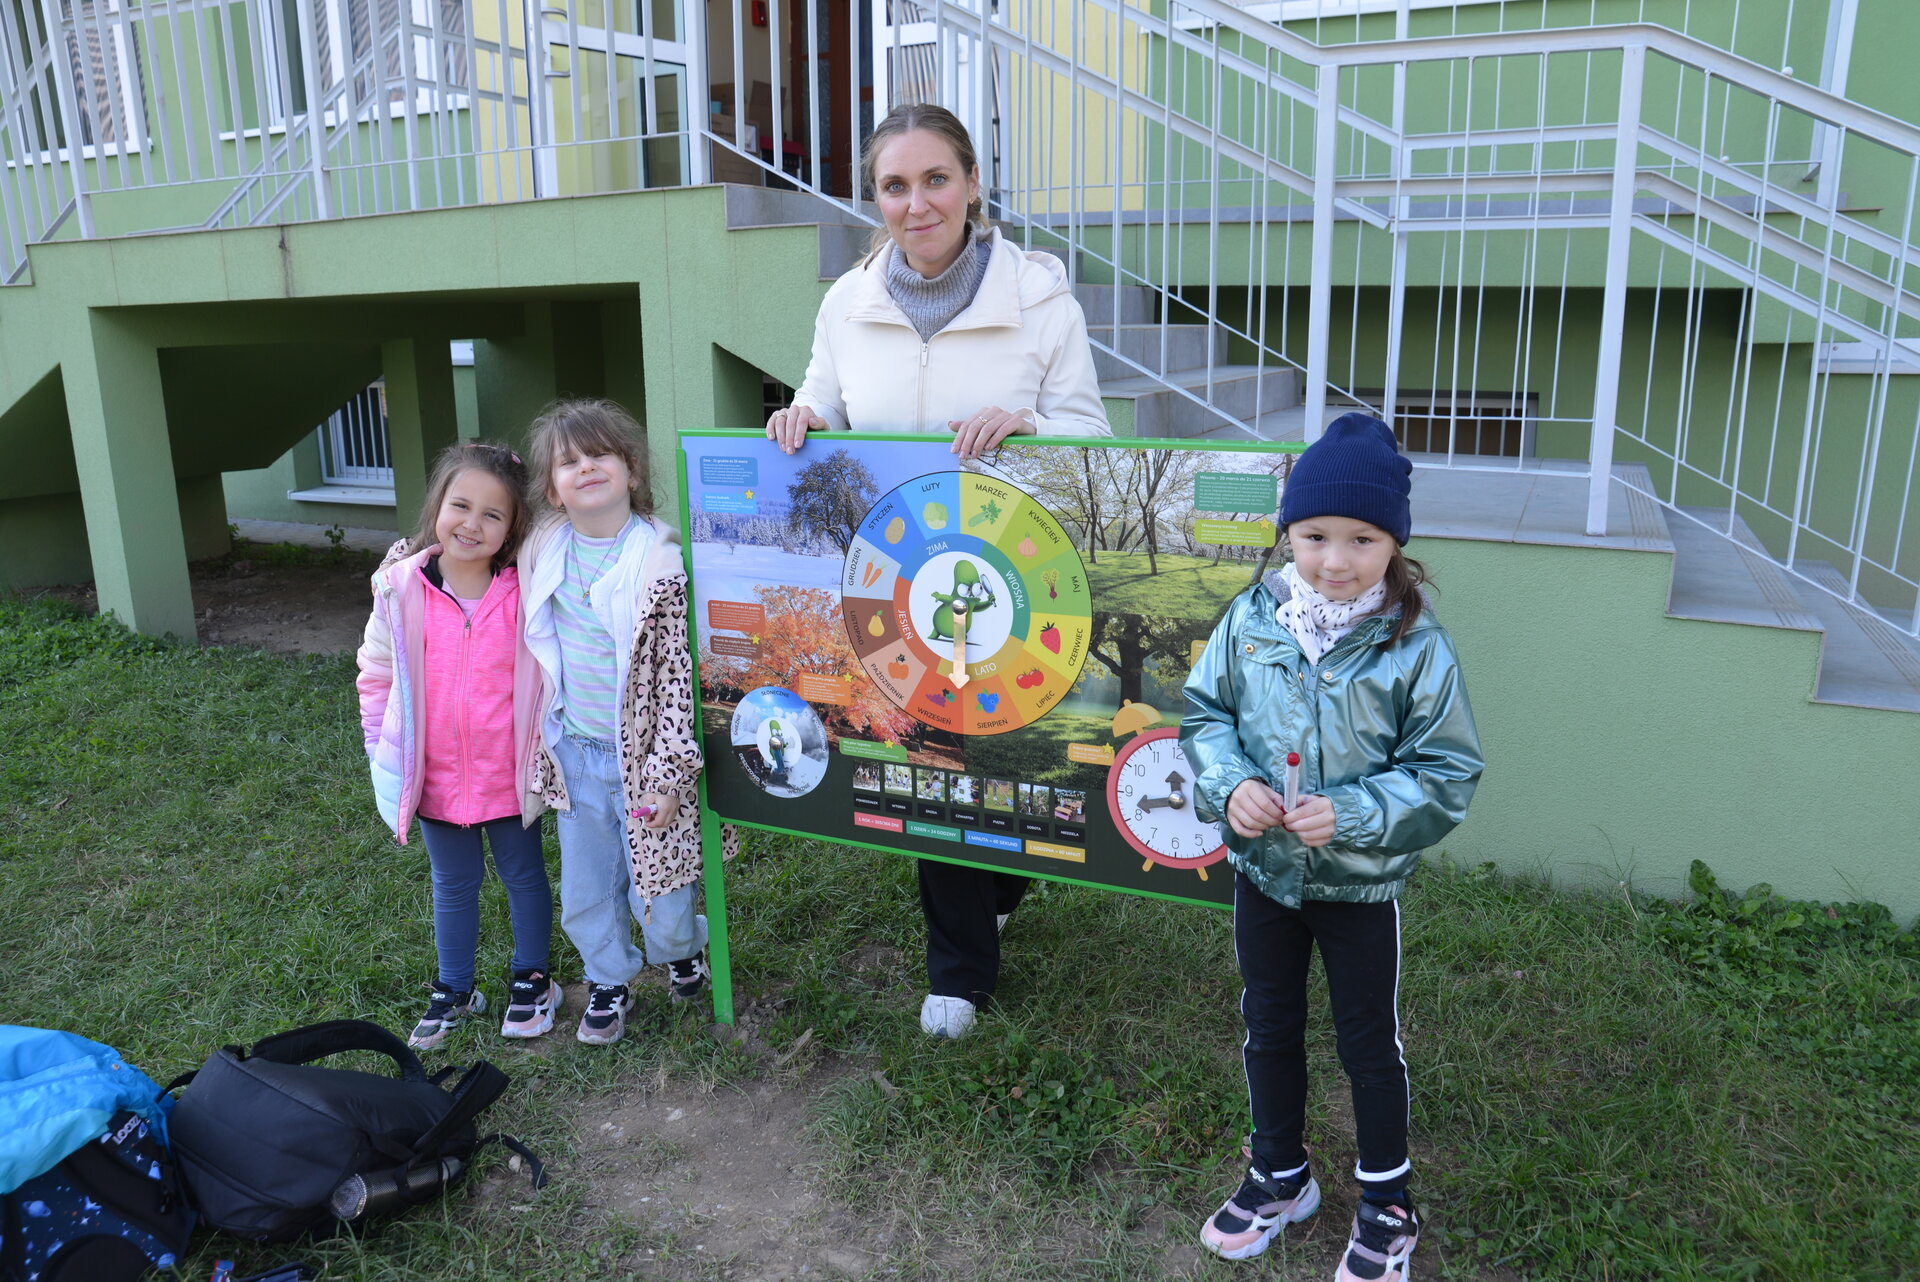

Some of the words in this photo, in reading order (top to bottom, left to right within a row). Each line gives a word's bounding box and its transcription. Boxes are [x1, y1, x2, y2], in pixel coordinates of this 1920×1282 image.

[921, 482, 941, 492] LUTY
[975, 483, 1008, 500] MARZEC
[1028, 510, 1061, 544] KWIECIEŃ
[926, 541, 948, 555] ZIMA
[848, 547, 862, 586] GRUDZIEŃ
[1005, 569, 1025, 609] WIOSNA
[1071, 575, 1081, 593] MAJ
[850, 610, 864, 645] LISTOPAD
[897, 609, 914, 640] JESIEŃ
[1068, 628, 1084, 667] CZERWIEC
[974, 662, 997, 676] LATO
[870, 663, 905, 701] PAŹDZIERNIK
[1036, 690, 1055, 709] LIPIEC
[917, 706, 952, 725] WRZESIEŃ
[976, 717, 1008, 729] SIERPIEŃ
[1153, 751, 1160, 763] 11
[1172, 747, 1184, 760] 12
[1134, 764, 1146, 777] 10
[1125, 785, 1133, 796] 9
[1135, 809, 1143, 821] 8
[1150, 827, 1158, 838] 7
[1171, 837, 1180, 849] 6
[1195, 834, 1203, 847] 5
